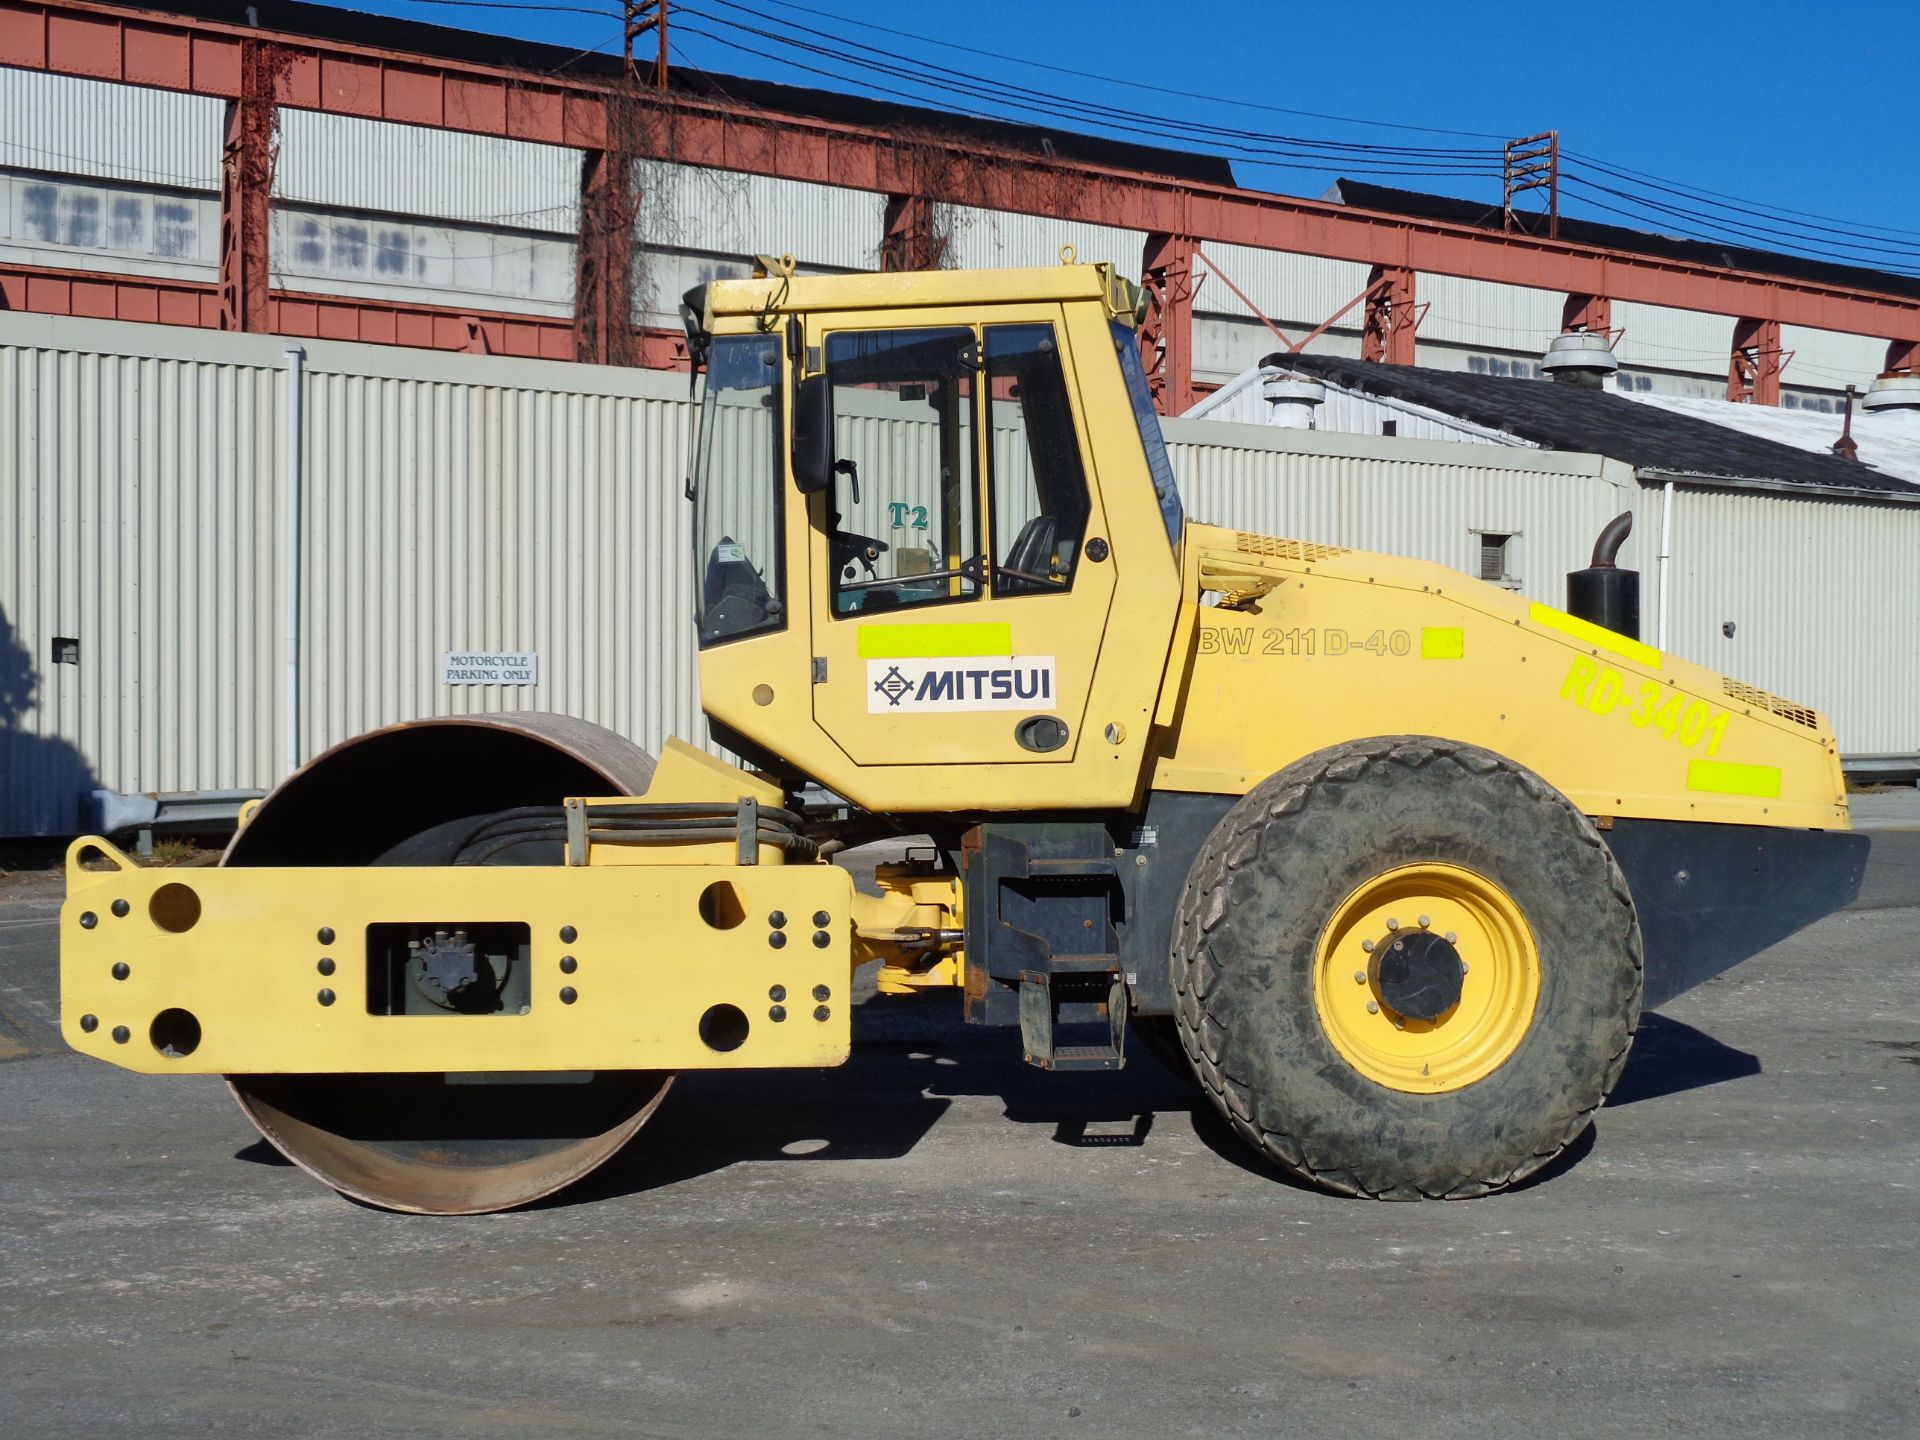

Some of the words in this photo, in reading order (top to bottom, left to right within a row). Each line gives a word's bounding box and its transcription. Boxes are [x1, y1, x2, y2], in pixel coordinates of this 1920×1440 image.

[888, 502, 928, 529] T2
[1197, 628, 1254, 654] BW
[1262, 628, 1316, 655] 211
[1323, 629, 1411, 656] D-40
[450, 656, 528, 666] MOTORCYCLE
[447, 670, 498, 680] PARKING
[503, 670, 532, 680] ONLY
[914, 669, 1050, 700] MITSUI
[1559, 655, 1731, 757] RD-3401
